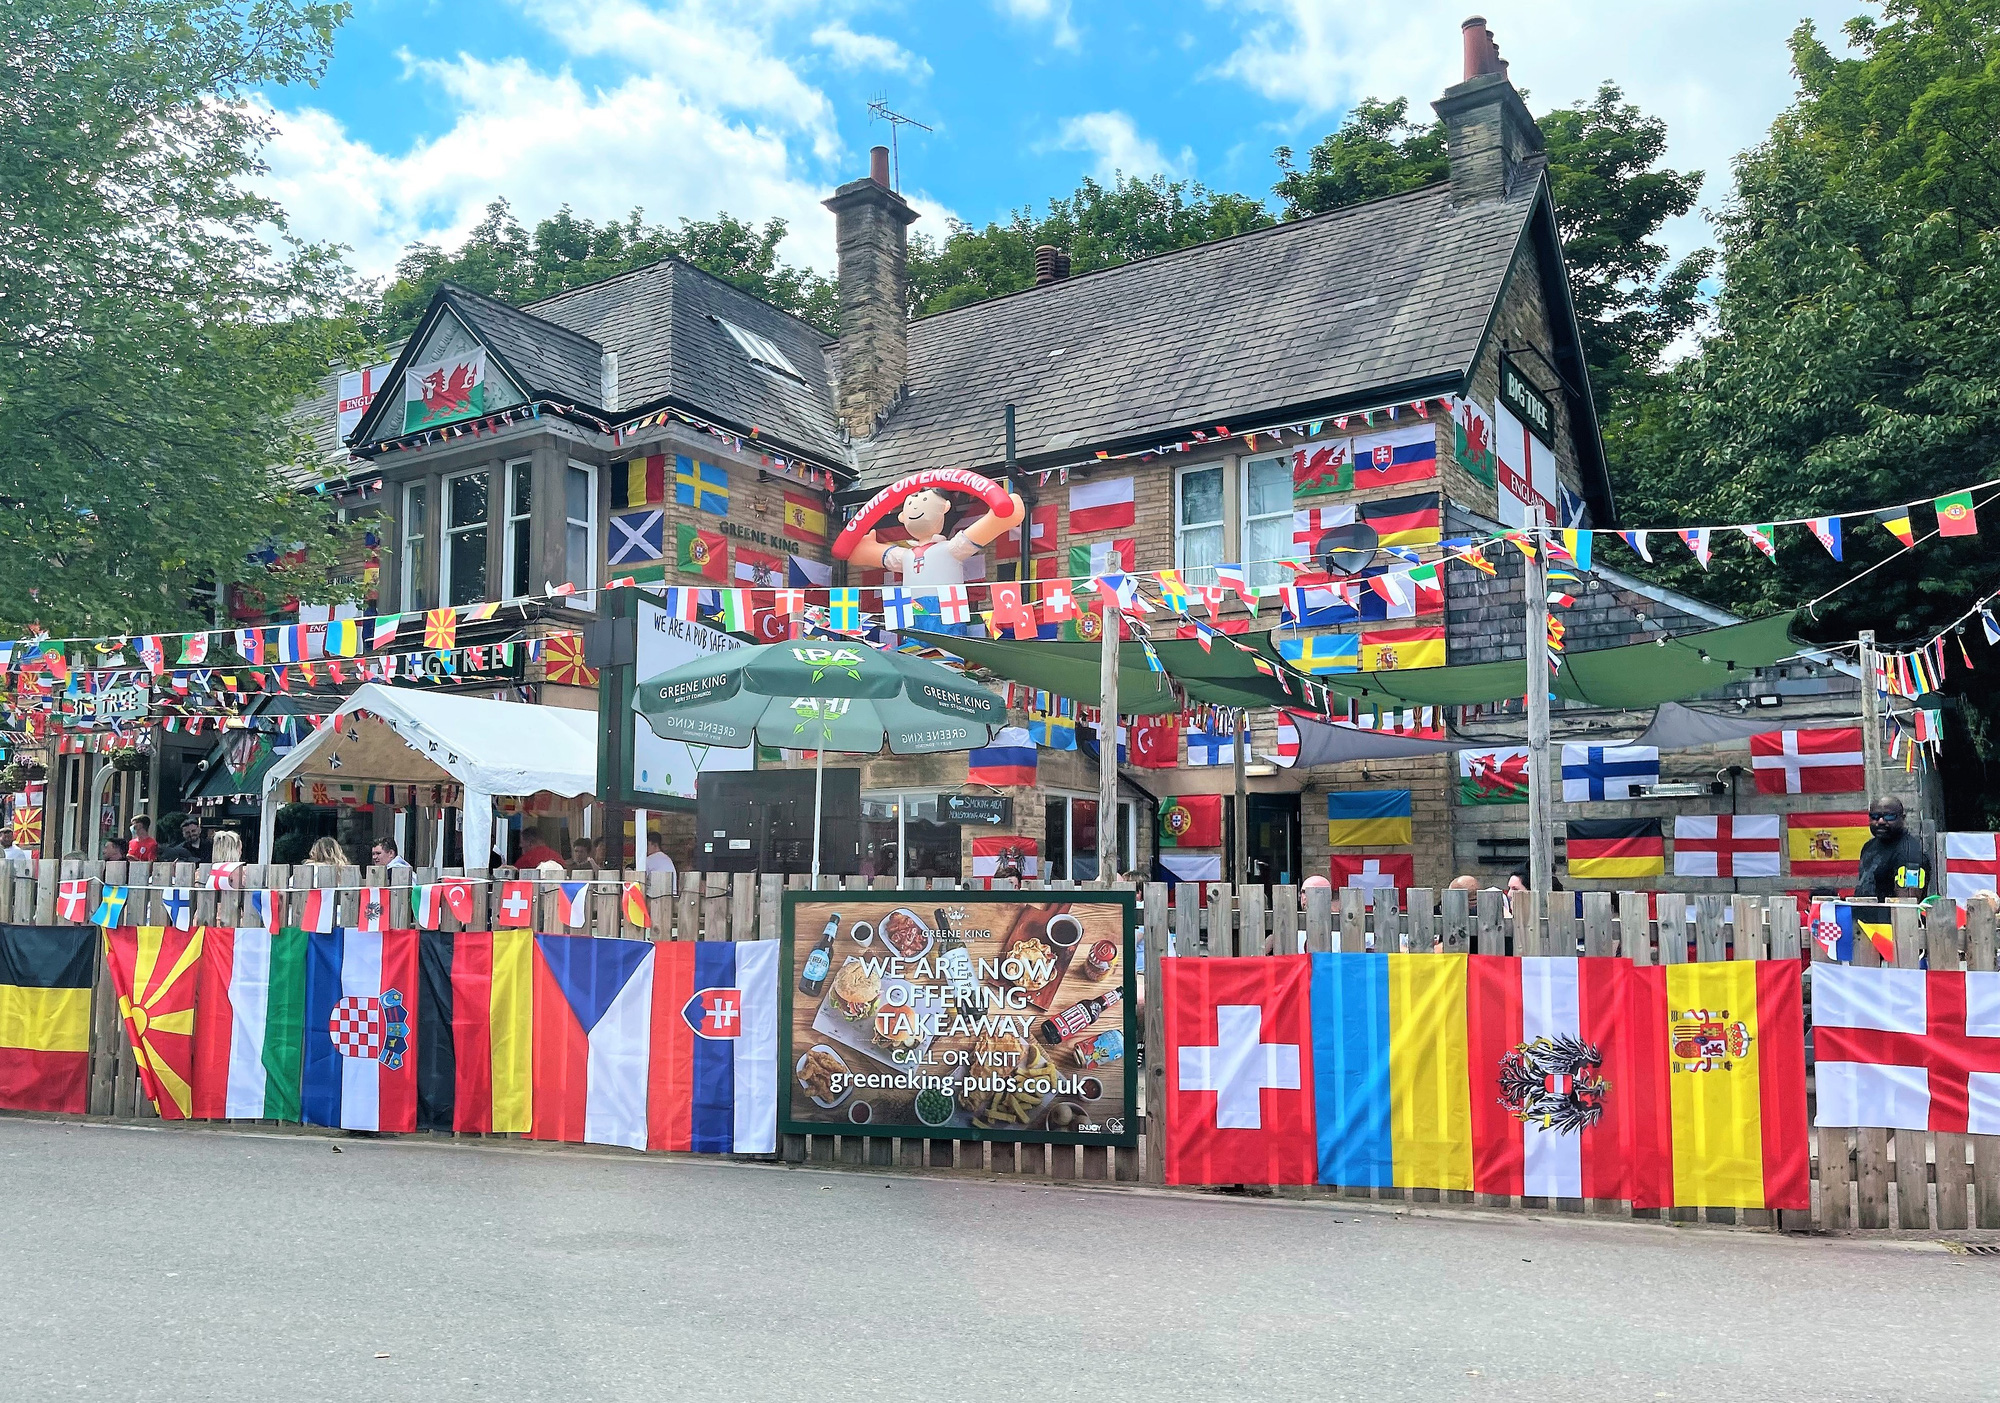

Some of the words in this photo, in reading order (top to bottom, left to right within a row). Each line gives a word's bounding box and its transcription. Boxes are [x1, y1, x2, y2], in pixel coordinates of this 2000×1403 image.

[1506, 372, 1525, 408] BIG
[1525, 389, 1548, 431] TREE
[846, 486, 889, 532] COME
[892, 474, 918, 494] ON
[919, 468, 997, 497] ENGLAND!
[719, 520, 767, 545] GREENE
[770, 535, 799, 555] KING
[654, 612, 667, 633] WE
[668, 618, 684, 639] ARE
[685, 623, 692, 642] A
[693, 625, 708, 650] PUB
[791, 647, 866, 663] IPA
[659, 680, 699, 699] GREENE
[701, 673, 727, 690] KING
[923, 685, 962, 704] GREENE
[963, 695, 991, 711] KING
[964, 796, 989, 809] SMOKING
[990, 800, 1003, 810] AREA
[921, 929, 961, 938] GREENE
[964, 929, 991, 938] KING
[859, 956, 906, 980] WE
[913, 957, 969, 980] ARE
[978, 957, 1056, 982] NOW
[885, 985, 1028, 1010] OFFERING
[877, 1012, 1037, 1039] TAKEAWAY
[891, 1049, 938, 1066] CALL
[943, 1050, 971, 1066] OR
[975, 1051, 1021, 1068] VISIT
[829, 1067, 1087, 1098] greeneking-pubs.co.uk
[1078, 1123, 1102, 1132] ENJOY
